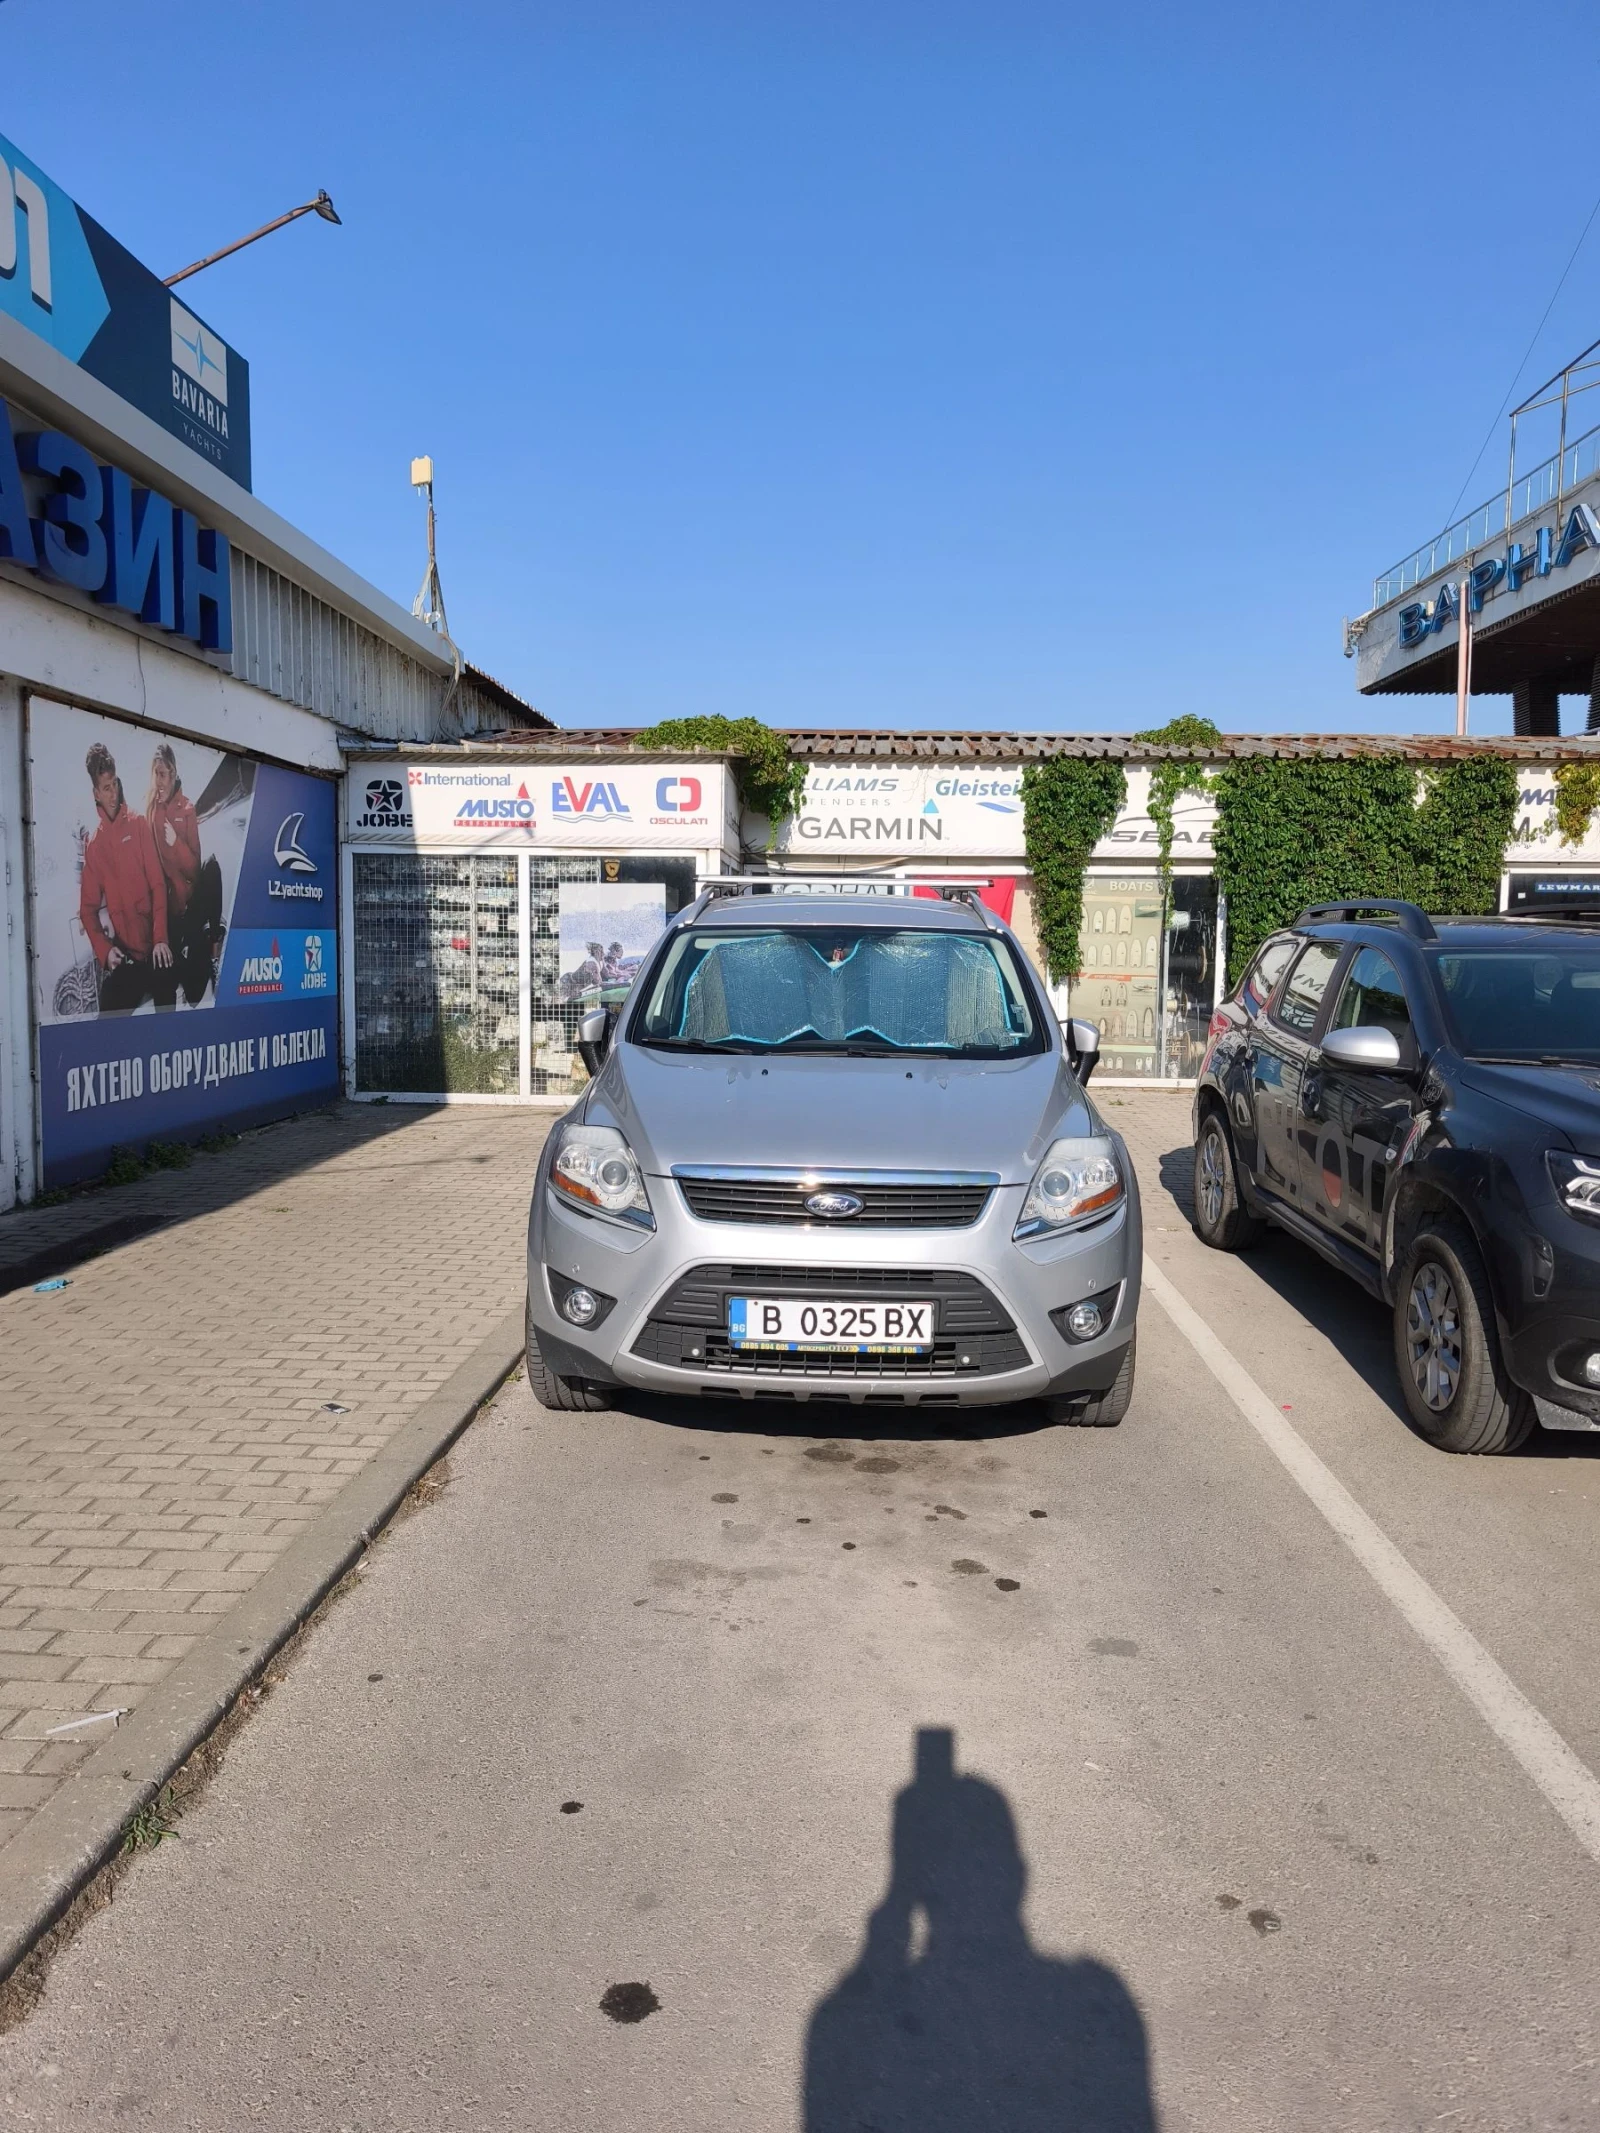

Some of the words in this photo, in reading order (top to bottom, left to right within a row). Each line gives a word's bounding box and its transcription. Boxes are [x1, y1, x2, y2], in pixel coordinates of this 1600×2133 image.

[172, 369, 229, 439] BAVARIA
[183, 422, 222, 460] YACHTS
[1398, 503, 1600, 649] ВАРНА
[424, 772, 511, 787] International
[803, 778, 899, 792] LIAMS
[551, 776, 631, 813] EVAL
[809, 798, 891, 807] TENDERS
[456, 799, 535, 819] MUSTO
[356, 813, 413, 828] JOBE
[454, 819, 536, 828] PERFORMANCE
[649, 817, 708, 826] OSCULATI
[797, 816, 943, 841] GARMIN
[1109, 880, 1154, 892] BOATS
[240, 956, 283, 983] MUSTO
[238, 983, 283, 995] PERFORMANCE
[301, 972, 327, 990] JOBE
[67, 1056, 144, 1112] ЯХТЕНО
[149, 1038, 255, 1094] ОБОРУДВАНЕ
[259, 1036, 268, 1071] И
[272, 1027, 327, 1068] ОБЛЕКЛА
[813, 1198, 849, 1212] Ford
[731, 1323, 746, 1334] BG
[762, 1305, 782, 1335] B
[800, 1306, 877, 1338] 0325
[884, 1308, 925, 1339] BX
